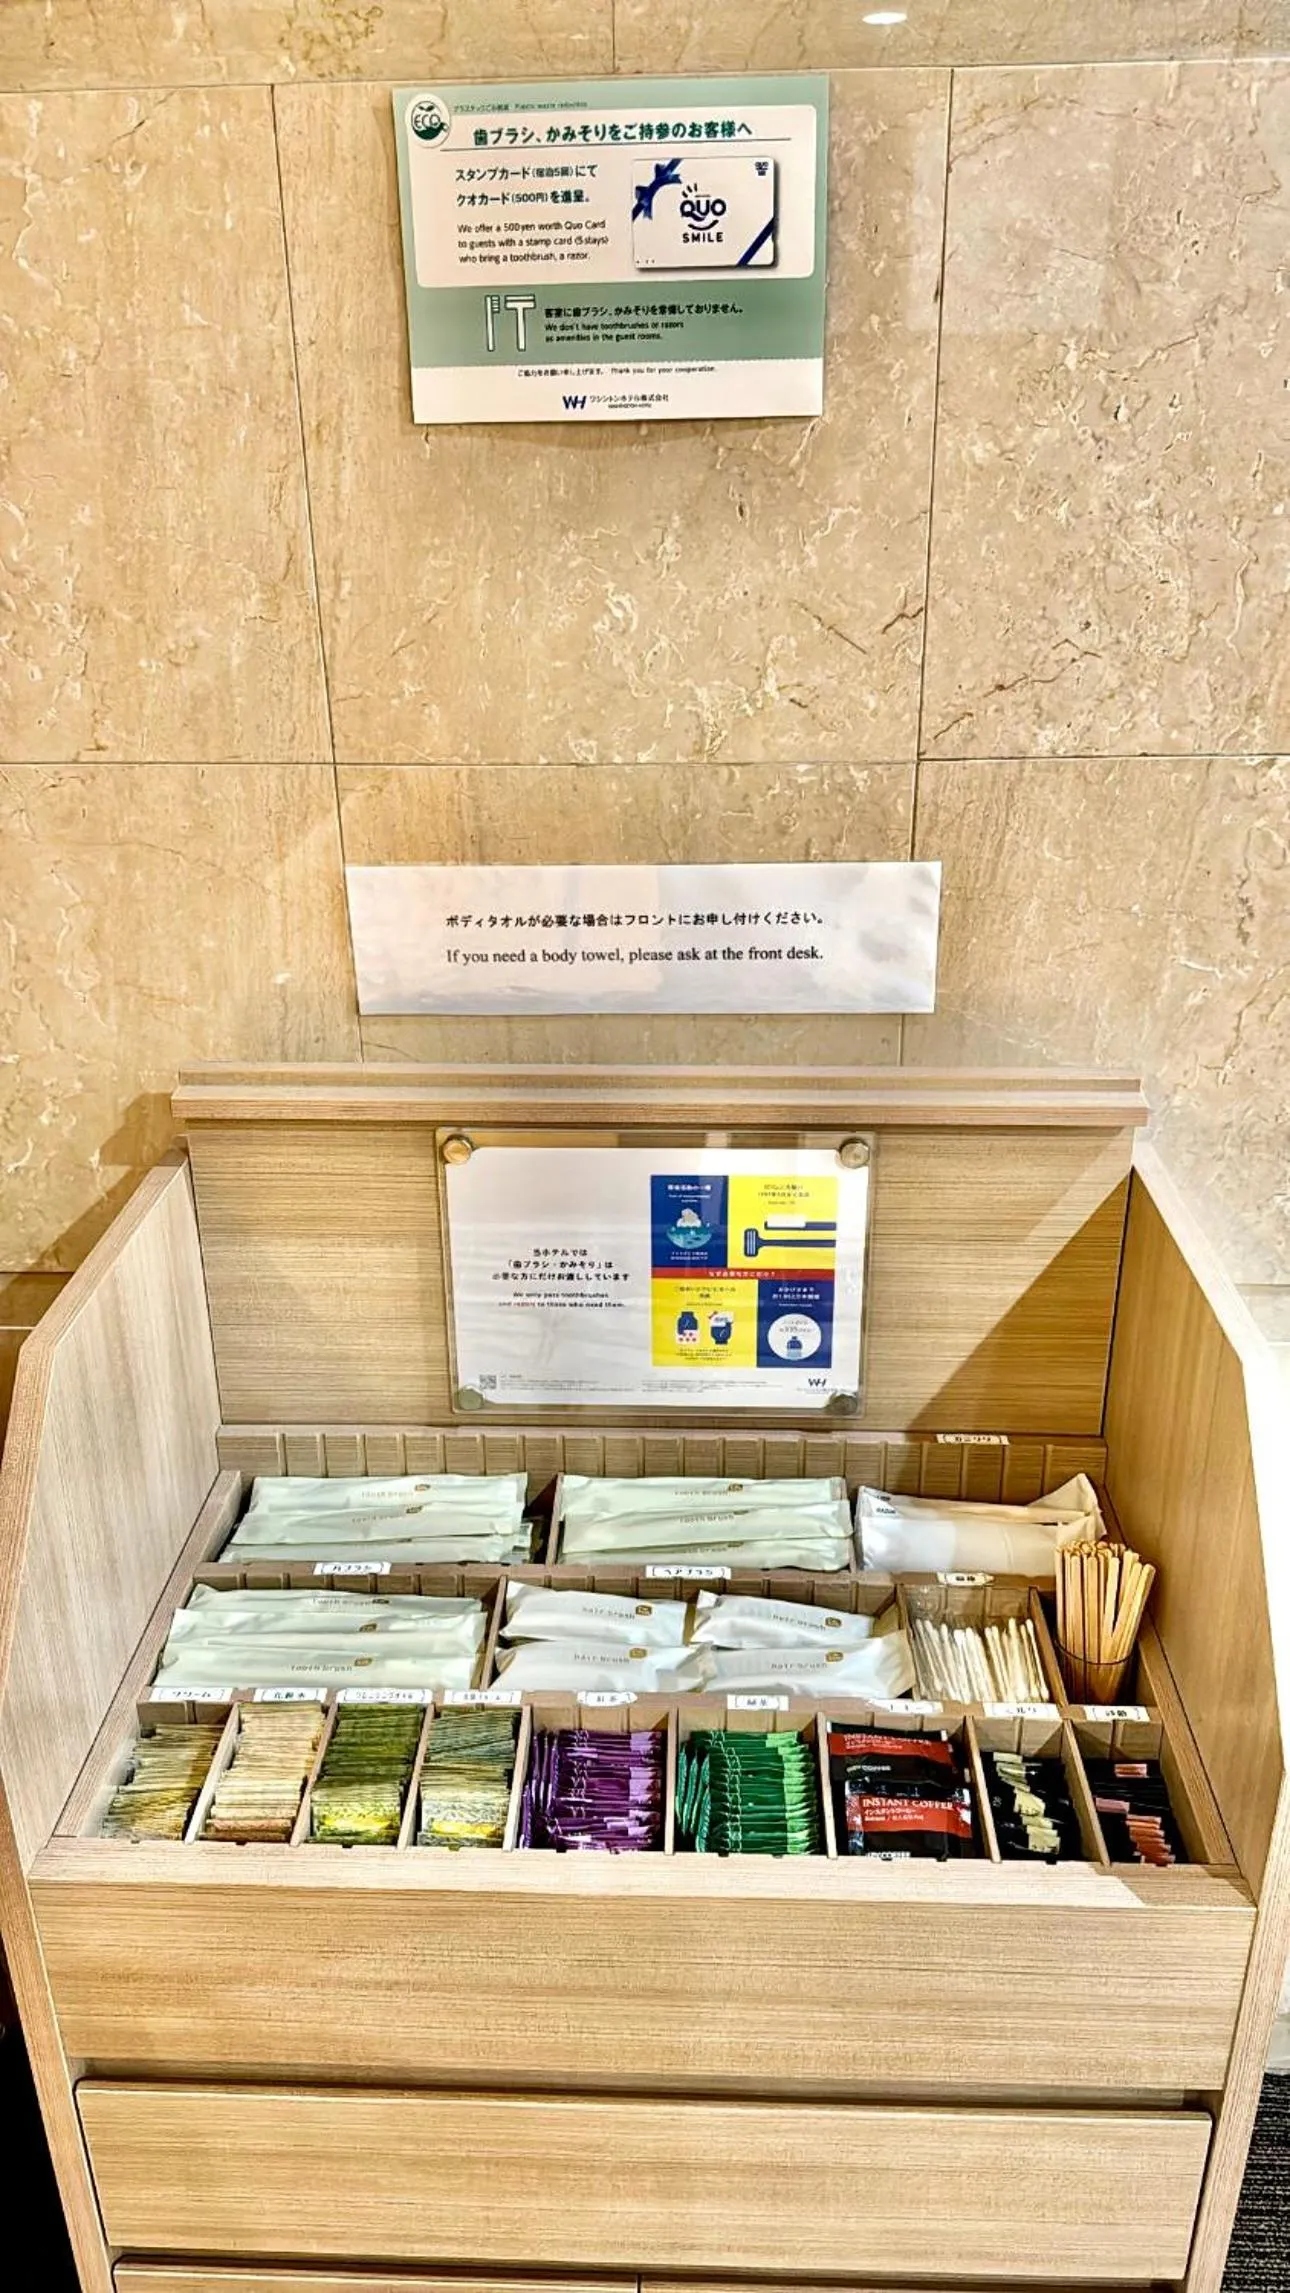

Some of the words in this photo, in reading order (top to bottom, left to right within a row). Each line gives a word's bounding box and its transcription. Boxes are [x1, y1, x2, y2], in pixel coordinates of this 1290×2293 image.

[414, 114, 441, 132] ECO
[474, 121, 752, 146] 歯ブラシ、かみそりをご持参のお客様へ
[680, 199, 726, 222] QUO
[458, 224, 473, 234] We
[474, 224, 493, 233] offer
[538, 222, 562, 231] worth
[565, 221, 582, 230] Quo
[585, 220, 606, 229] Card
[458, 240, 468, 248] to
[469, 240, 496, 250] guests
[498, 238, 516, 247] with
[526, 238, 551, 248] stamp
[554, 237, 572, 246] card
[682, 232, 724, 244] SMILE
[459, 255, 477, 264] who
[479, 254, 500, 265] bring
[545, 323, 558, 332] We
[582, 322, 598, 330] have
[600, 322, 649, 330] toothbrushes
[651, 322, 658, 330] or
[556, 334, 590, 342] amenities
[592, 334, 600, 342] in
[602, 332, 613, 341] the
[616, 332, 635, 342] guest
[633, 368, 644, 376] you
[446, 912, 824, 928] ボディタオルが必要な場合はフロントにお申し付けください。
[446, 950, 460, 964] If
[462, 952, 489, 966] you
[492, 949, 526, 964] need
[530, 953, 538, 963] a
[542, 948, 577, 966] body
[581, 948, 624, 964] towel,
[629, 948, 673, 965] please
[676, 948, 701, 962] ask
[704, 949, 718, 962] at
[722, 948, 744, 961] the
[748, 946, 782, 960] front
[786, 946, 824, 960] desk.
[533, 1248, 588, 1257] 当ホテルでは
[862, 1798, 910, 1808] INSTANT
[912, 1800, 953, 1810] COFFEE
